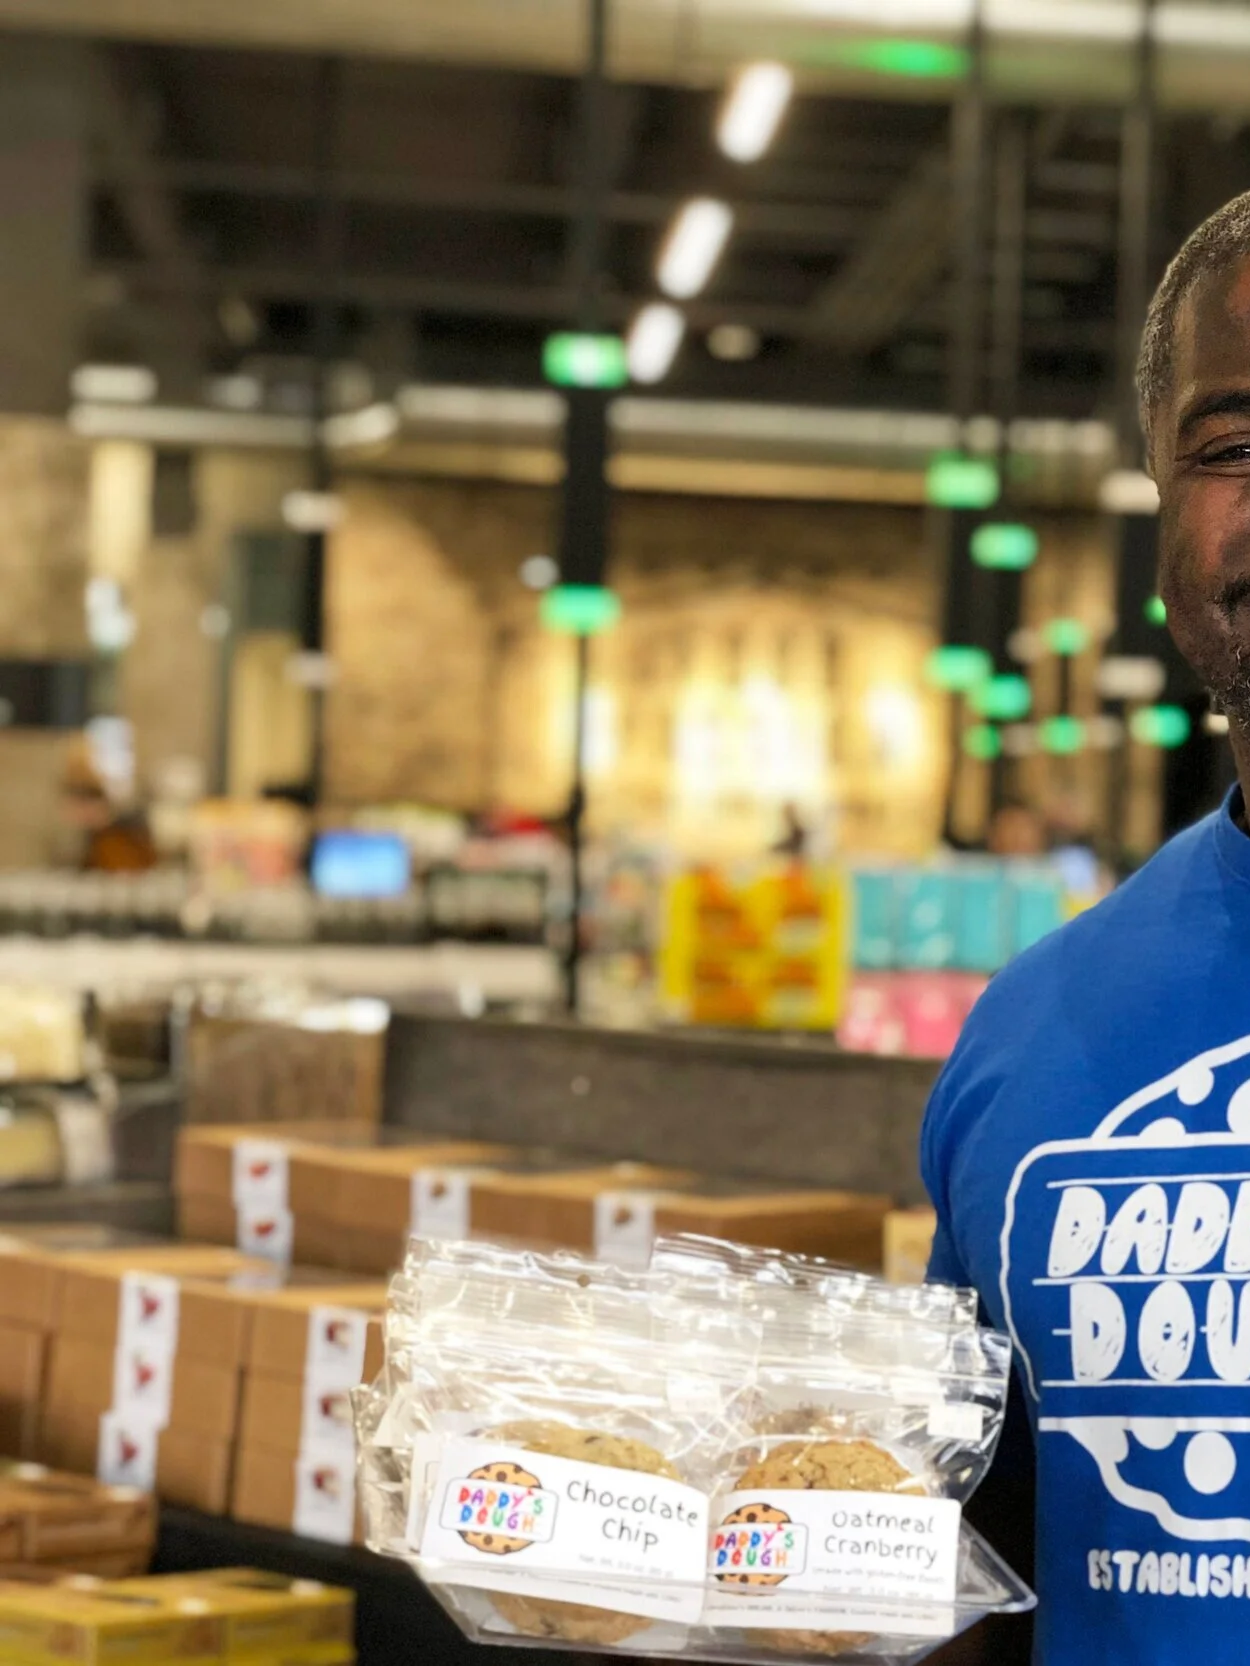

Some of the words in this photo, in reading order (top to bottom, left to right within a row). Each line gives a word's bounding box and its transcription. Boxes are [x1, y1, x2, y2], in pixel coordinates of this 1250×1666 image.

[458, 1486, 543, 1515] DADDY'S
[566, 1480, 699, 1527] Chocolate
[460, 1504, 536, 1530] DOUGH
[832, 1510, 935, 1534] Oatmeal
[602, 1518, 659, 1553] Chip
[714, 1523, 795, 1549] DADDY'S
[716, 1549, 789, 1567] DOUGH
[824, 1535, 938, 1569] Cranberry
